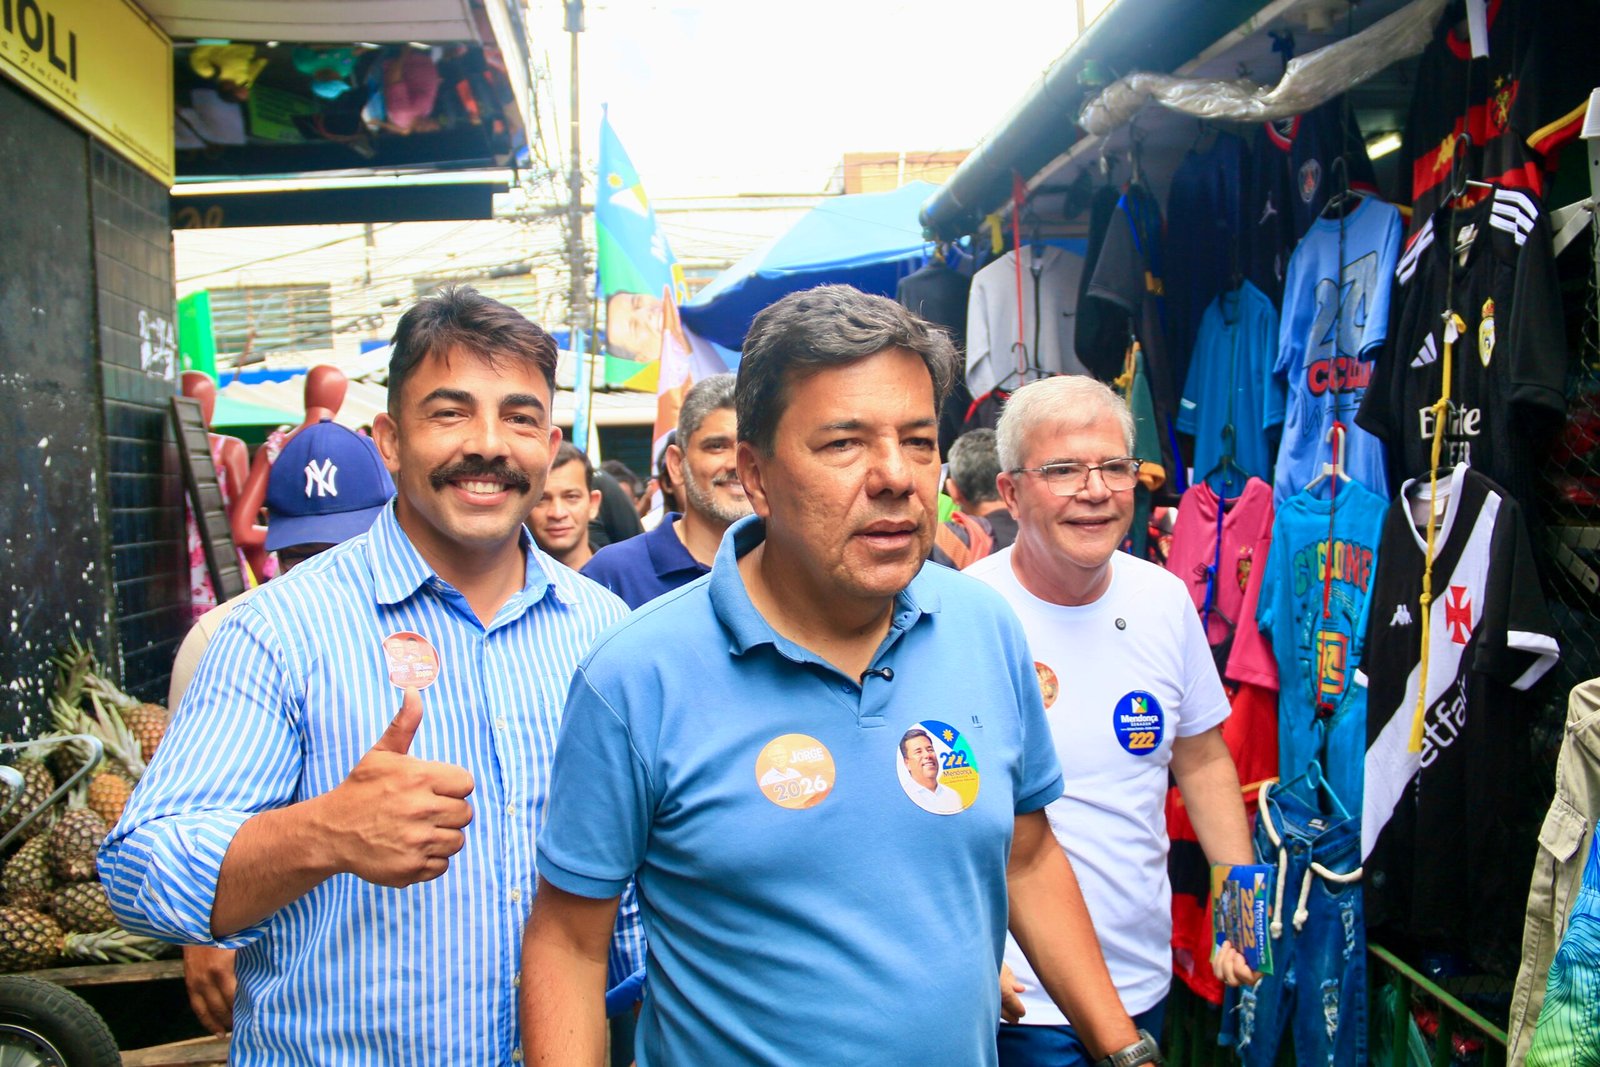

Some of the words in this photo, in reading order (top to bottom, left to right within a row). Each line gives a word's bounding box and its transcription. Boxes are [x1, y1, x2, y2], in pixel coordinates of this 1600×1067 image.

[304, 457, 338, 498] NY
[1120, 714, 1159, 724] Mendonça
[1128, 731, 1156, 749] 222
[789, 747, 825, 764] JORGE
[940, 750, 970, 770] 222
[773, 774, 828, 802] 2026
[1240, 888, 1255, 948] 222
